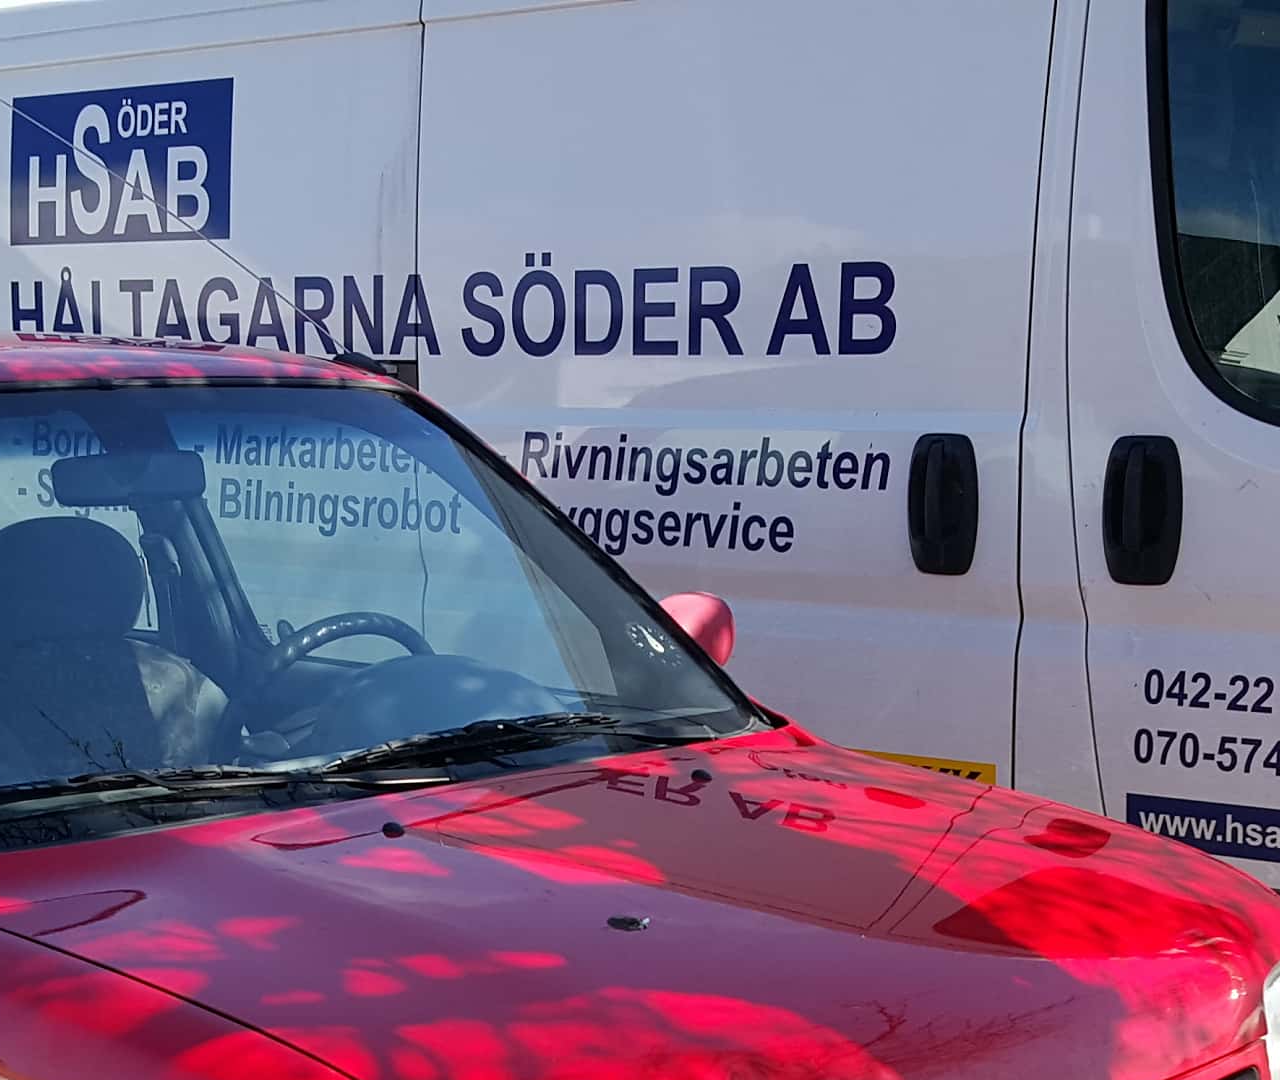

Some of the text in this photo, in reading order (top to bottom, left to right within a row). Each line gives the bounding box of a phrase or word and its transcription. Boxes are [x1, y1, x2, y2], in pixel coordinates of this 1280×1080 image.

[117, 99, 188, 139] ÖDER
[461, 252, 744, 357] SÖDER
[766, 261, 897, 355] AB
[216, 424, 433, 474] Markarbete
[521, 431, 891, 496] Rivningsarbeten
[220, 478, 462, 536] Bilningsrobot
[1144, 669, 1274, 714] 042-22
